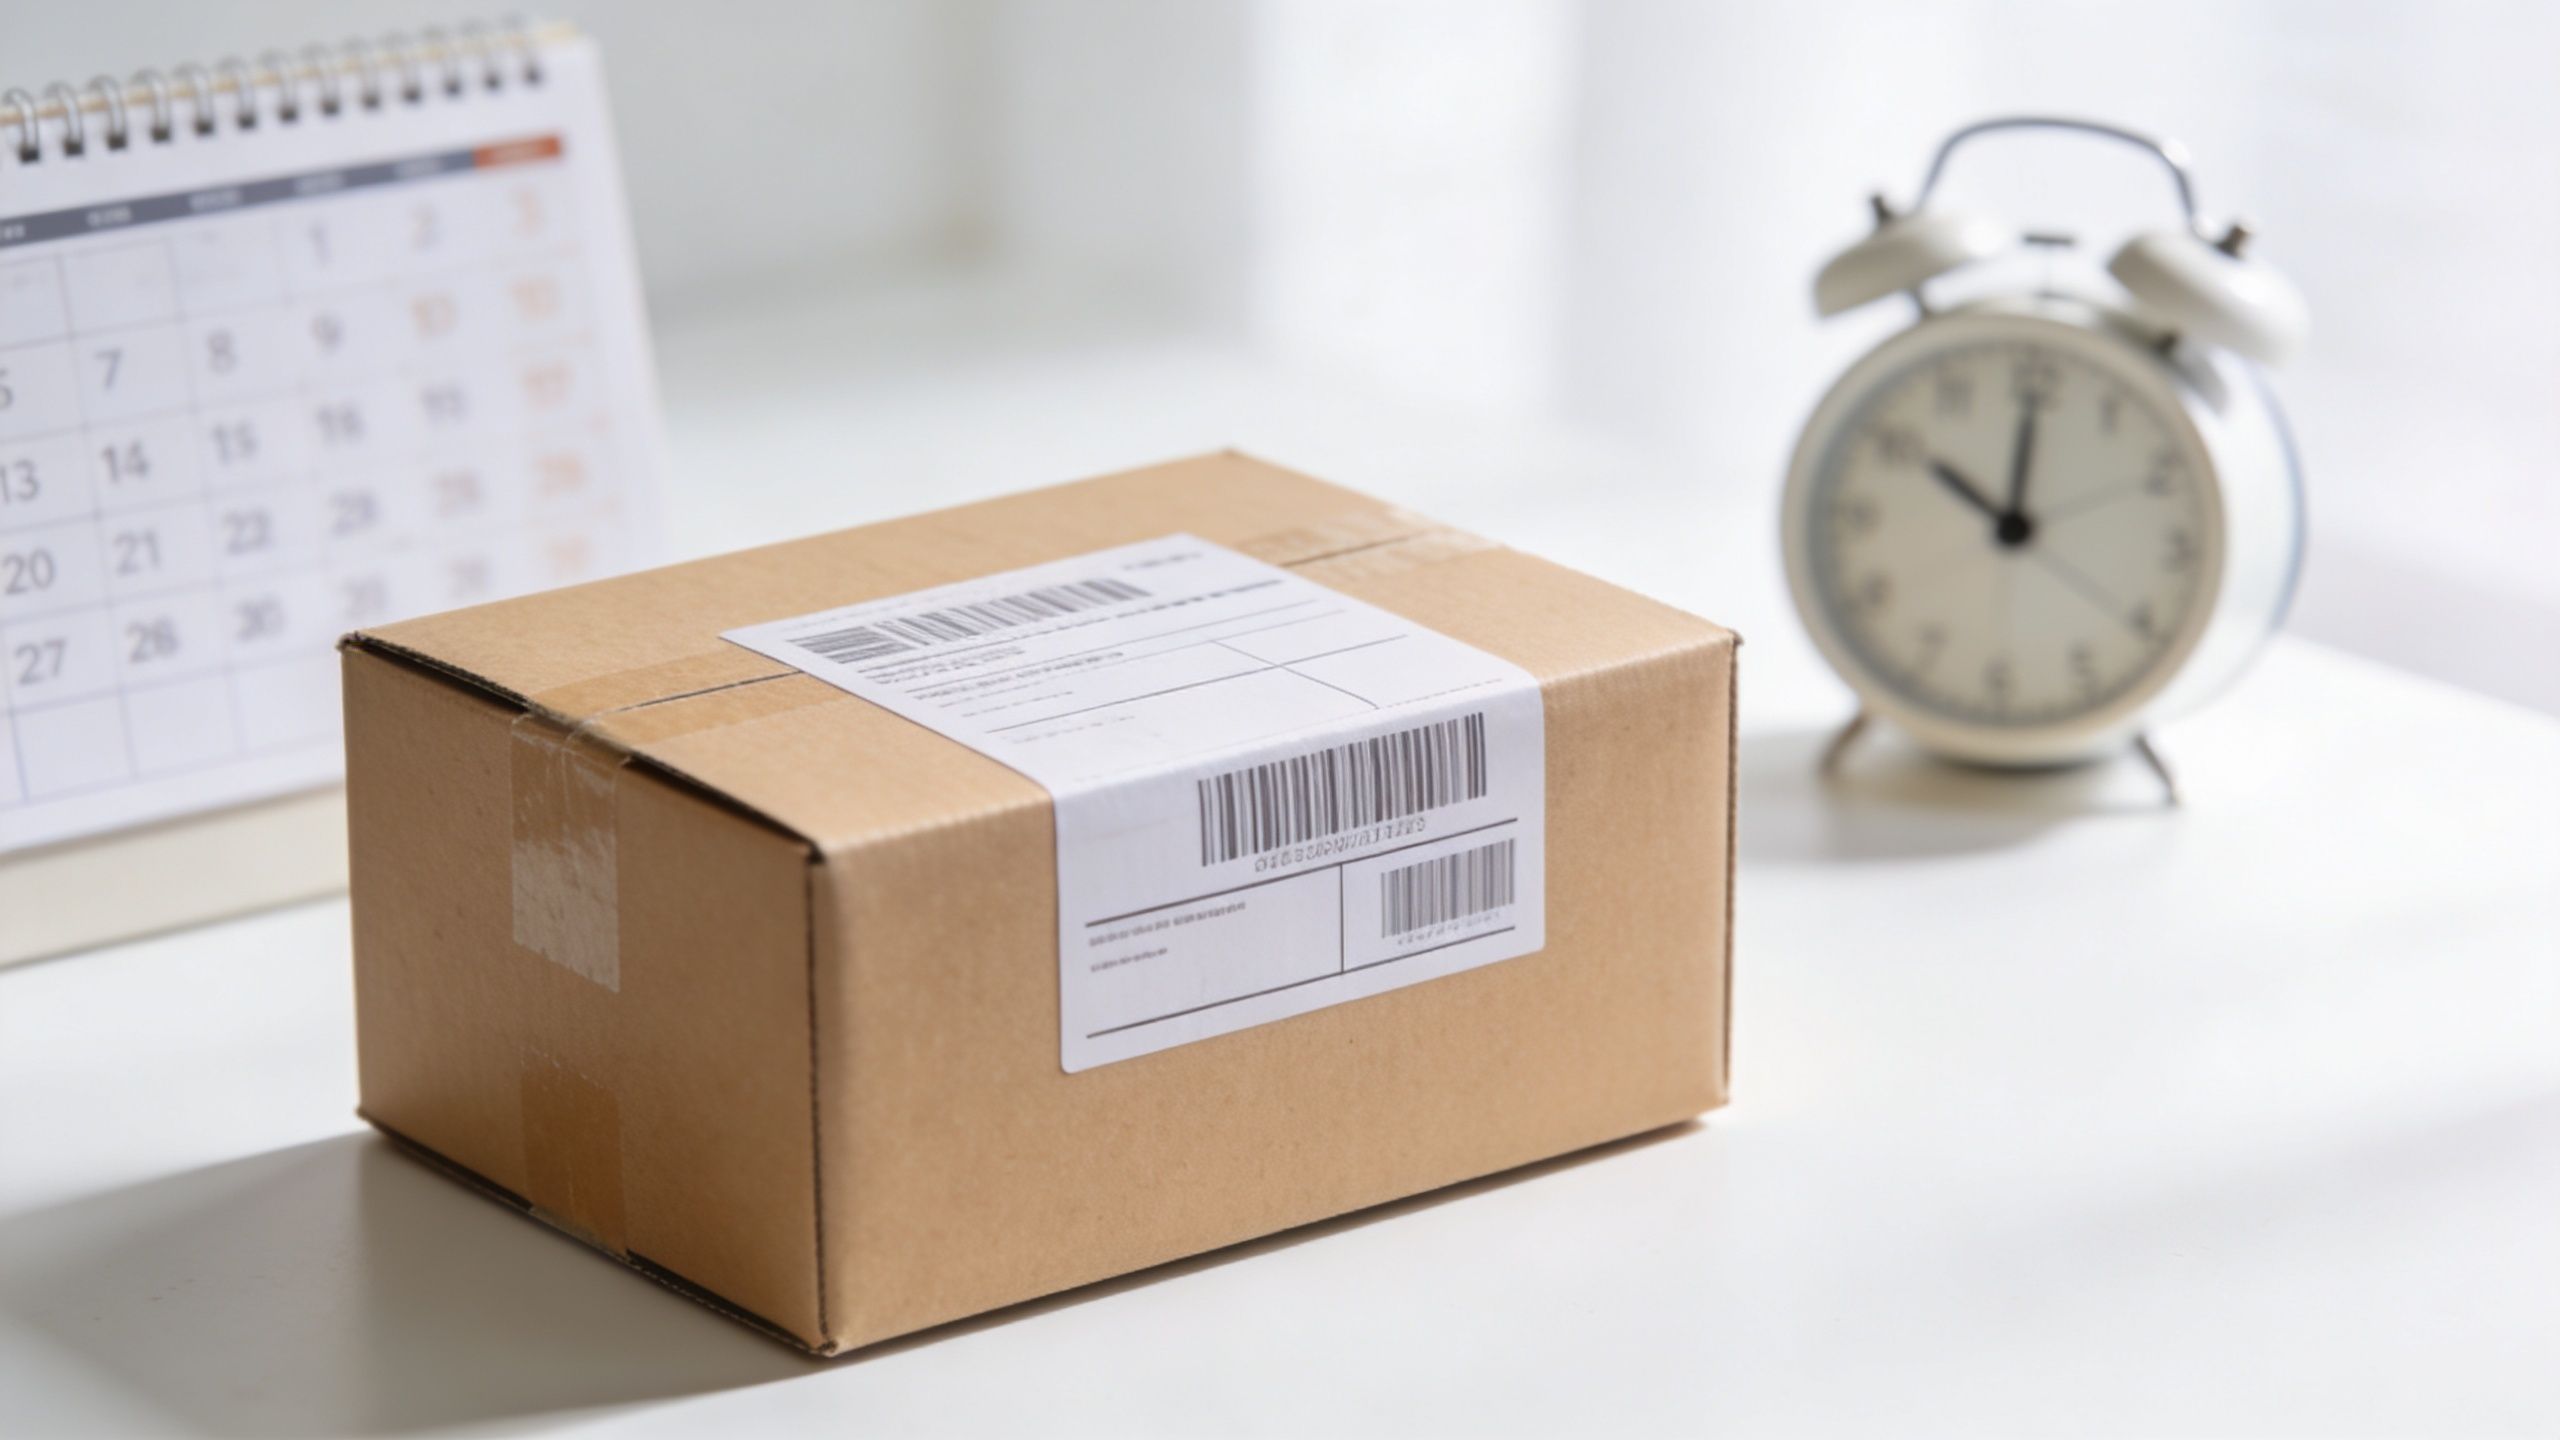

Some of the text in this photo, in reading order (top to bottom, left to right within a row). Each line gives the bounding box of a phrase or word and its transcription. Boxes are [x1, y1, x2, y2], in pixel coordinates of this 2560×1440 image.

[95, 348, 123, 391] 7
[207, 330, 237, 375] 8
[0, 459, 41, 504] 13
[102, 439, 151, 484] 14
[213, 420, 259, 465] 15
[2, 547, 56, 596] 20
[114, 528, 161, 577] 21
[224, 507, 272, 554] 22
[15, 637, 67, 685] 27
